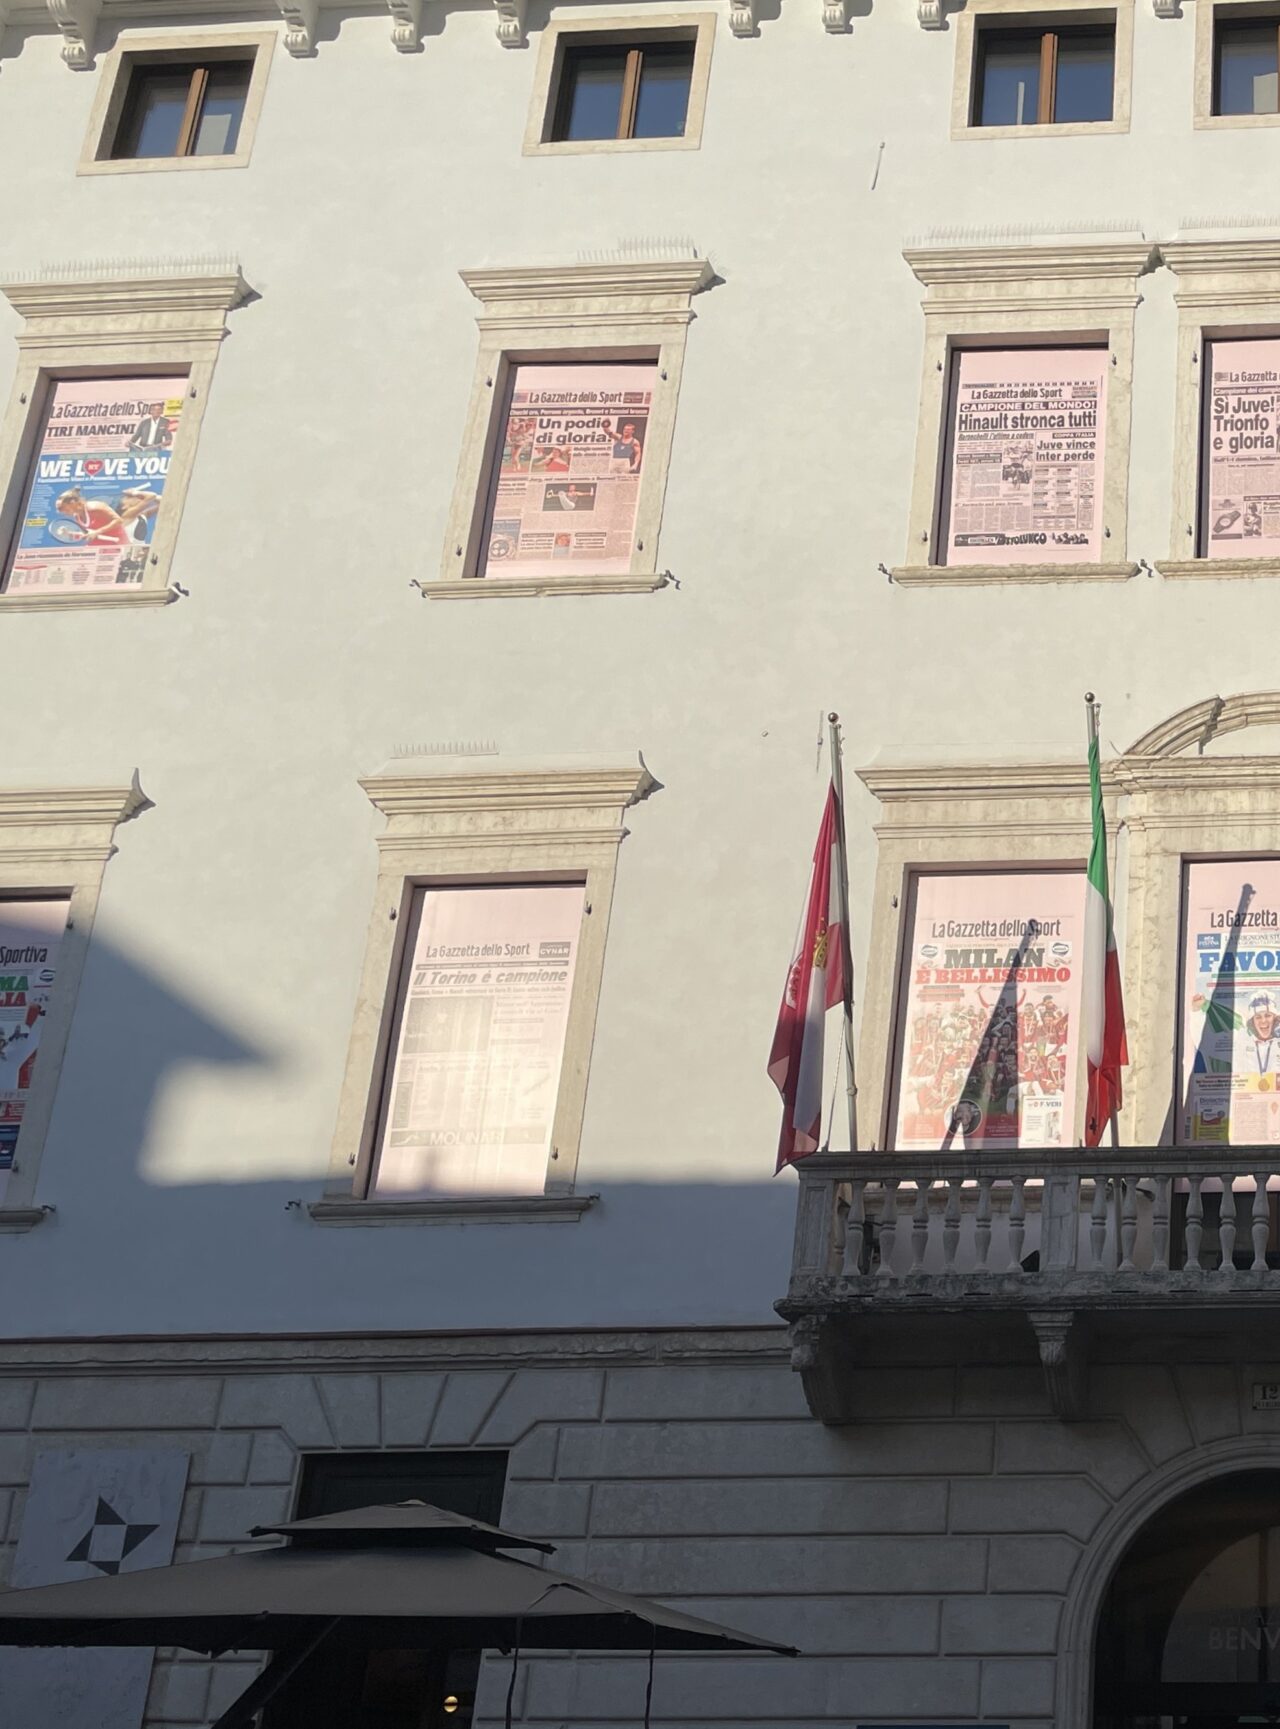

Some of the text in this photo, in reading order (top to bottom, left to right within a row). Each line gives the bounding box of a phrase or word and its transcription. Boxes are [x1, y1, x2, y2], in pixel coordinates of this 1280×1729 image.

[1230, 373, 1239, 382] La
[1241, 371, 1277, 382] Gazzetta
[529, 392, 622, 404] La Gazzetta dello Sport
[972, 388, 1063, 400] La Gazzetta dello Sport
[51, 401, 165, 418] La Gazzetta dello Spo
[961, 401, 1095, 411] CAMPIONE DEL MONDO!
[1214, 396, 1275, 414] Sì Juve!
[539, 418, 612, 434] Un podio
[958, 411, 1096, 430] Hinault stronca tutti
[1214, 414, 1269, 432] Trionfo
[47, 423, 136, 438] TIRI MANCINI
[536, 432, 553, 444] di
[1037, 439, 1095, 450] Juve vince
[1213, 432, 1275, 454] e gloria
[1036, 451, 1095, 462] Inter perde
[40, 456, 171, 478] WE LVE YOU
[1211, 913, 1224, 928] La
[1226, 910, 1278, 927] Gazzetta
[932, 919, 1061, 939] La Gazzetta dello Sport
[426, 943, 530, 958] La Gazzetta dello Sport
[944, 948, 1045, 968] MILAN
[413, 972, 426, 985] Il
[430, 970, 476, 985] Torino
[496, 969, 568, 985] campione
[934, 967, 1071, 984] BELLISSIMO
[1262, 1385, 1279, 1400] 12
